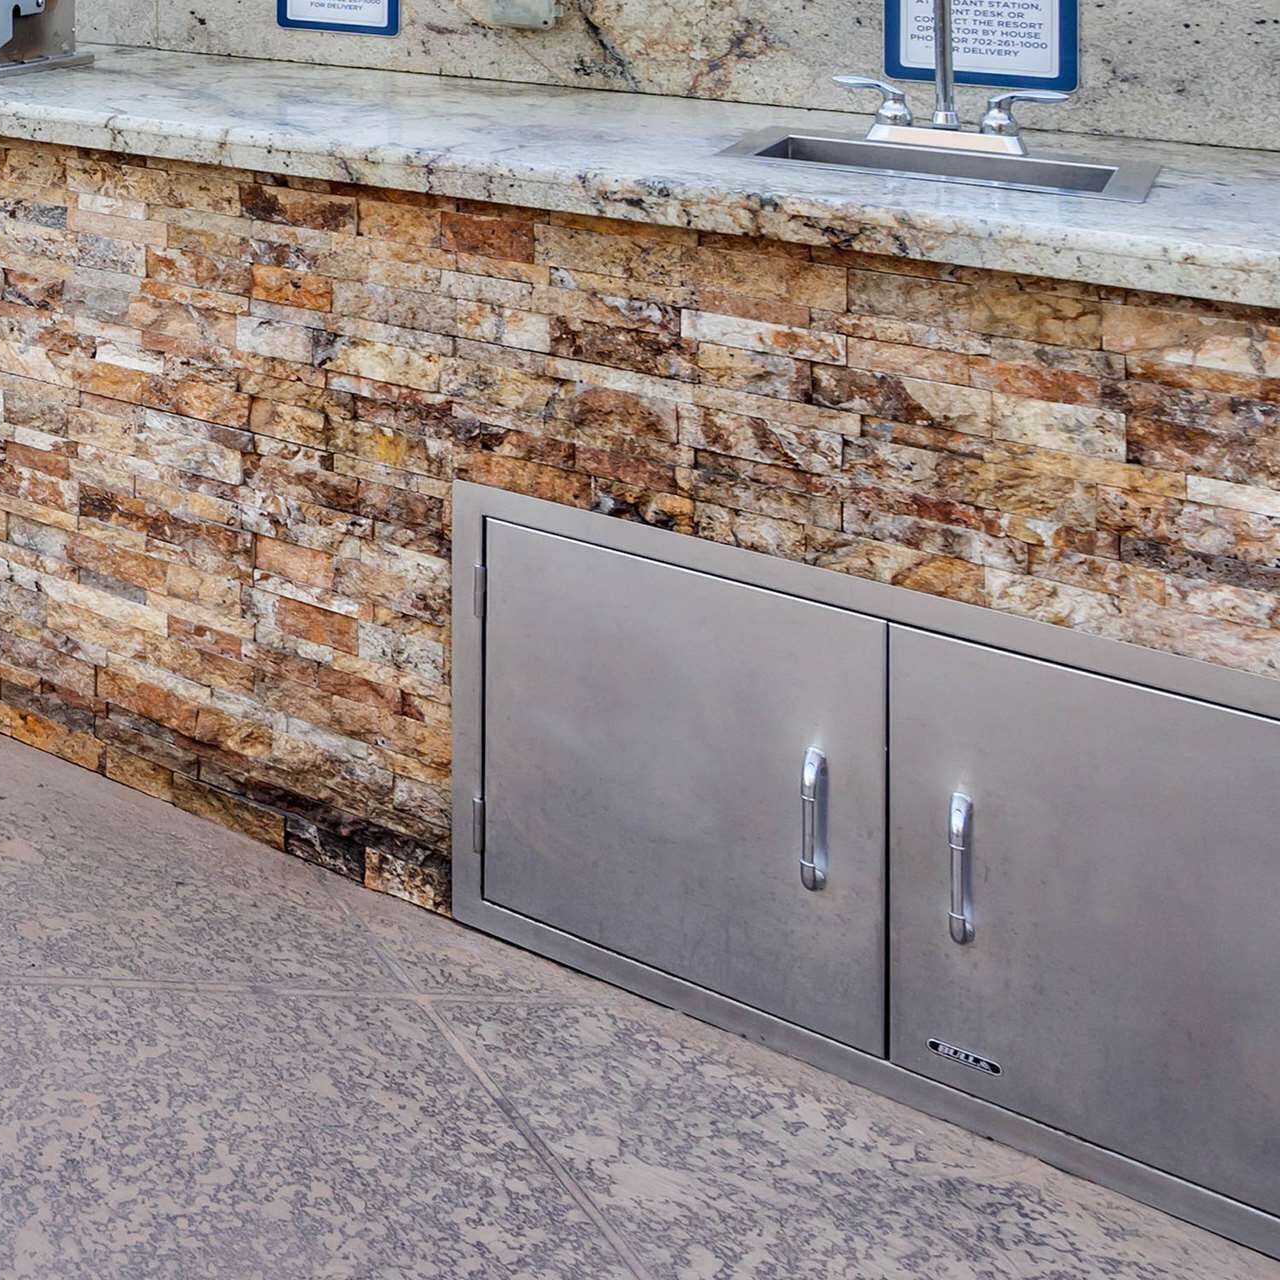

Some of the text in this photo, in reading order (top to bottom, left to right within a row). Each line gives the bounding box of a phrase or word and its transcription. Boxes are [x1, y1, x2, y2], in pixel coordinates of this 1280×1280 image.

[988, 0, 1042, 11] STATION,
[974, 9, 1003, 18] DESK
[1007, 11, 1025, 19] OR
[972, 19, 994, 27] THE
[997, 20, 1043, 29] RESORT
[982, 29, 997, 37] BY
[1001, 30, 1041, 40] HOUSE
[910, 33, 934, 42] PHO
[972, 37, 1048, 50] 702-261-1000
[963, 46, 1020, 57] DELIVERY
